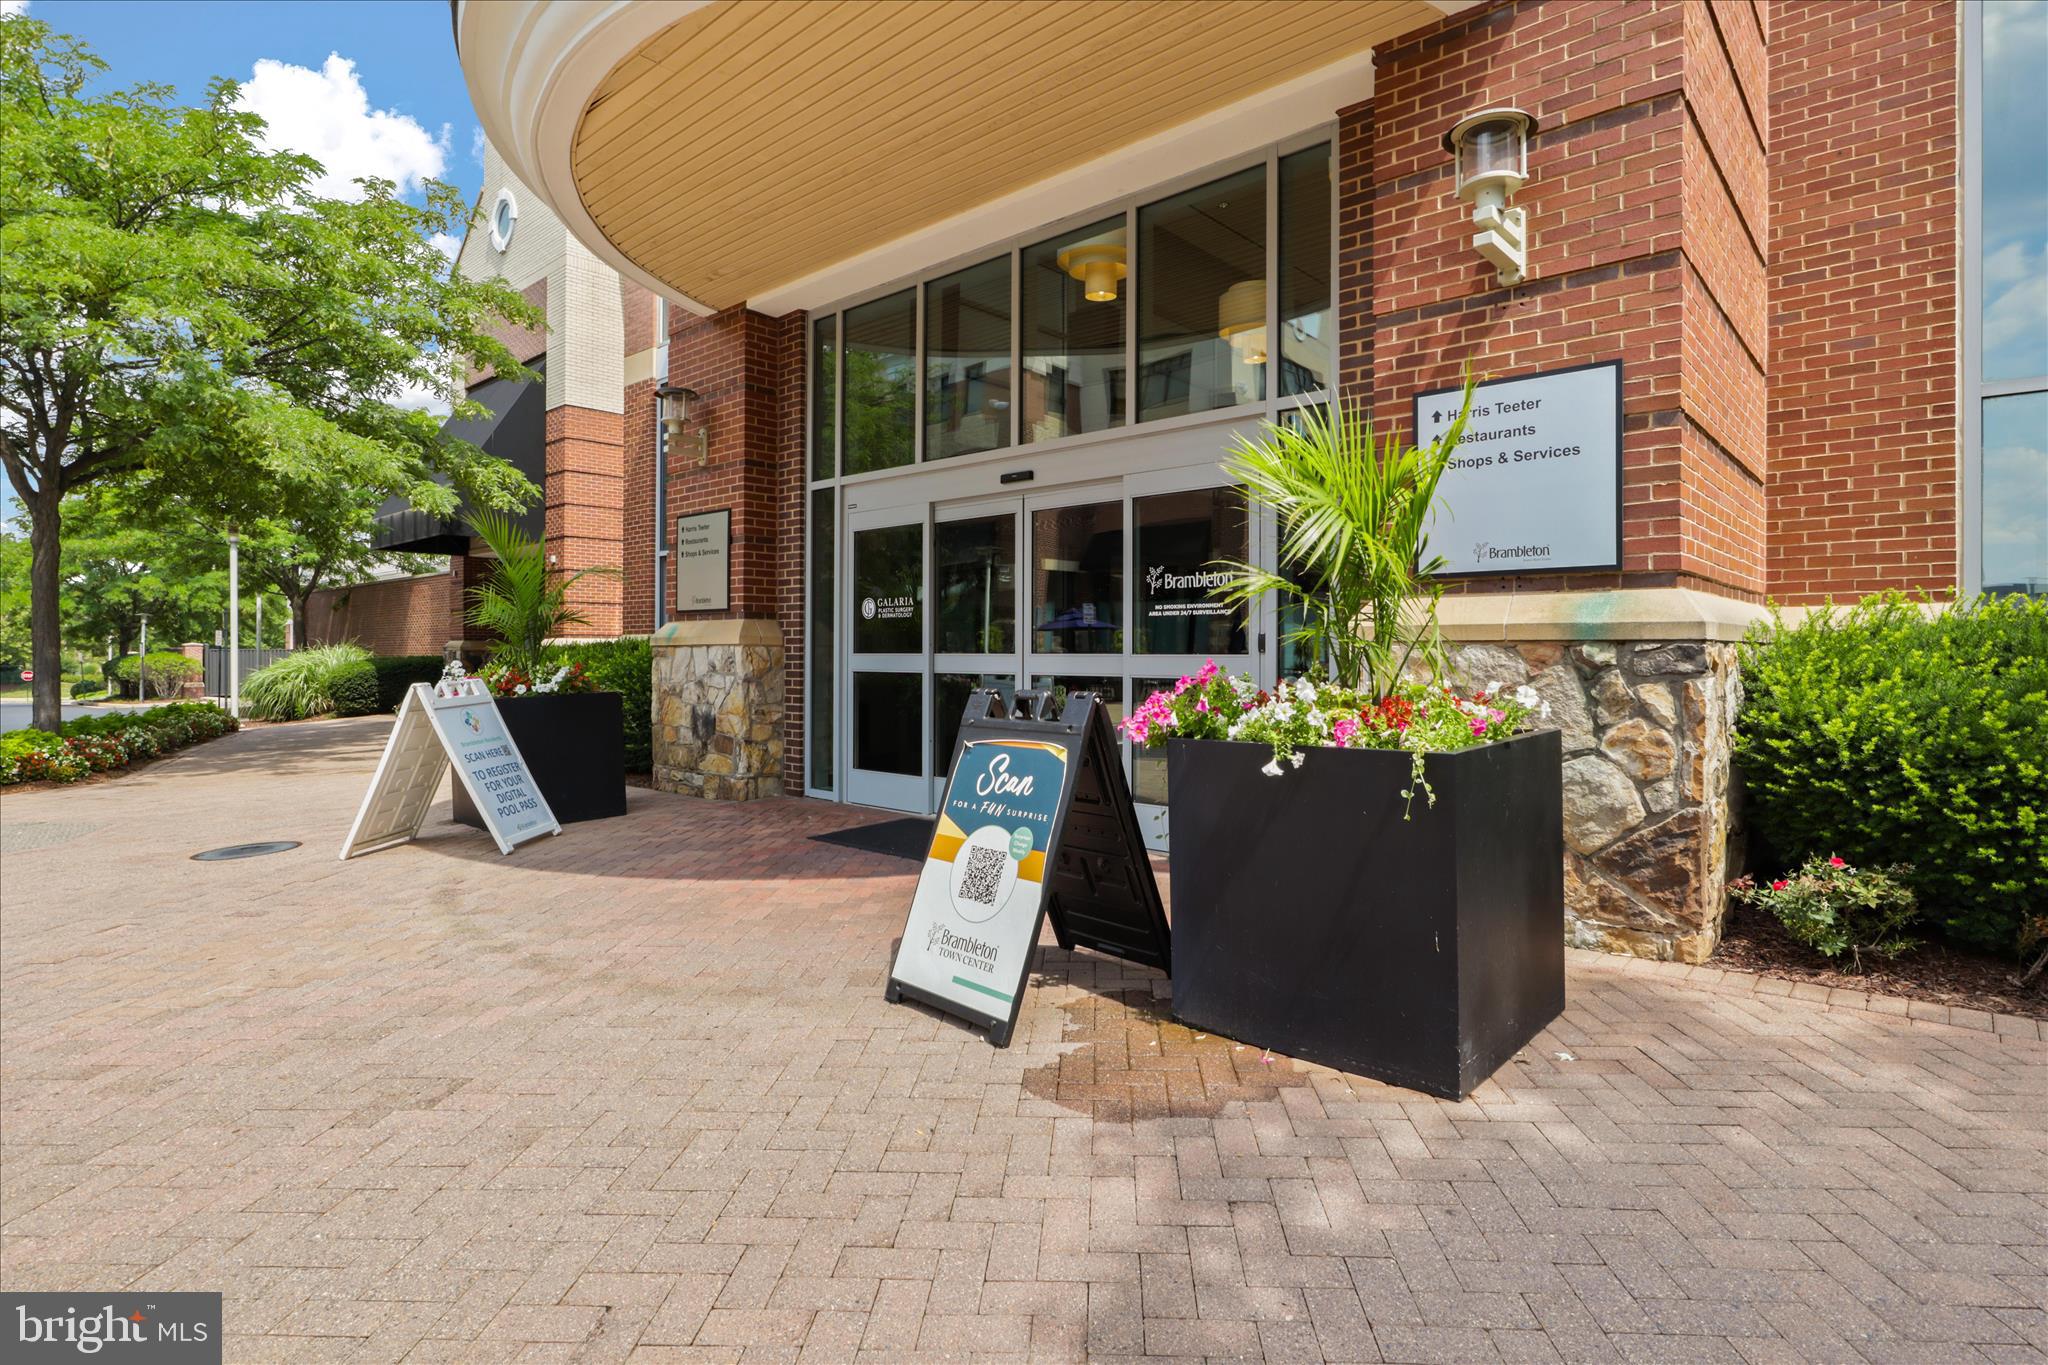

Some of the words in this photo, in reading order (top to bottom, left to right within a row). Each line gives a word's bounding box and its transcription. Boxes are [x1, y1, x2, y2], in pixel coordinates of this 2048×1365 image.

[1448, 405, 1490, 422] Hris
[1494, 399, 1542, 415] Teeter
[1456, 424, 1536, 445] estaurants
[1447, 455, 1493, 470] Shops
[1497, 451, 1509, 464] &
[1513, 445, 1581, 463] Services
[685, 550, 698, 558] Shops
[1489, 545, 1550, 559] Brambleton
[1164, 571, 1233, 589] Brambleton
[877, 597, 914, 606] GALARIA
[464, 752, 487, 763] SCAN
[486, 747, 504, 759] HERE
[472, 769, 487, 782] TO
[487, 762, 521, 777] REGISTER
[976, 753, 1034, 796] Scan
[484, 779, 502, 793] FOR
[502, 774, 525, 788] YOUR
[496, 788, 527, 804] DIGITAL
[497, 803, 520, 818] POOL
[519, 797, 538, 812] PASS
[953, 800, 968, 808] FOR
[972, 802, 977, 810] A
[980, 801, 1006, 817] FUN
[1006, 808, 1049, 822] SURPRISE
[941, 928, 998, 962] Brambleton
[938, 946, 961, 963] TOWN
[962, 954, 995, 974] CENTER
